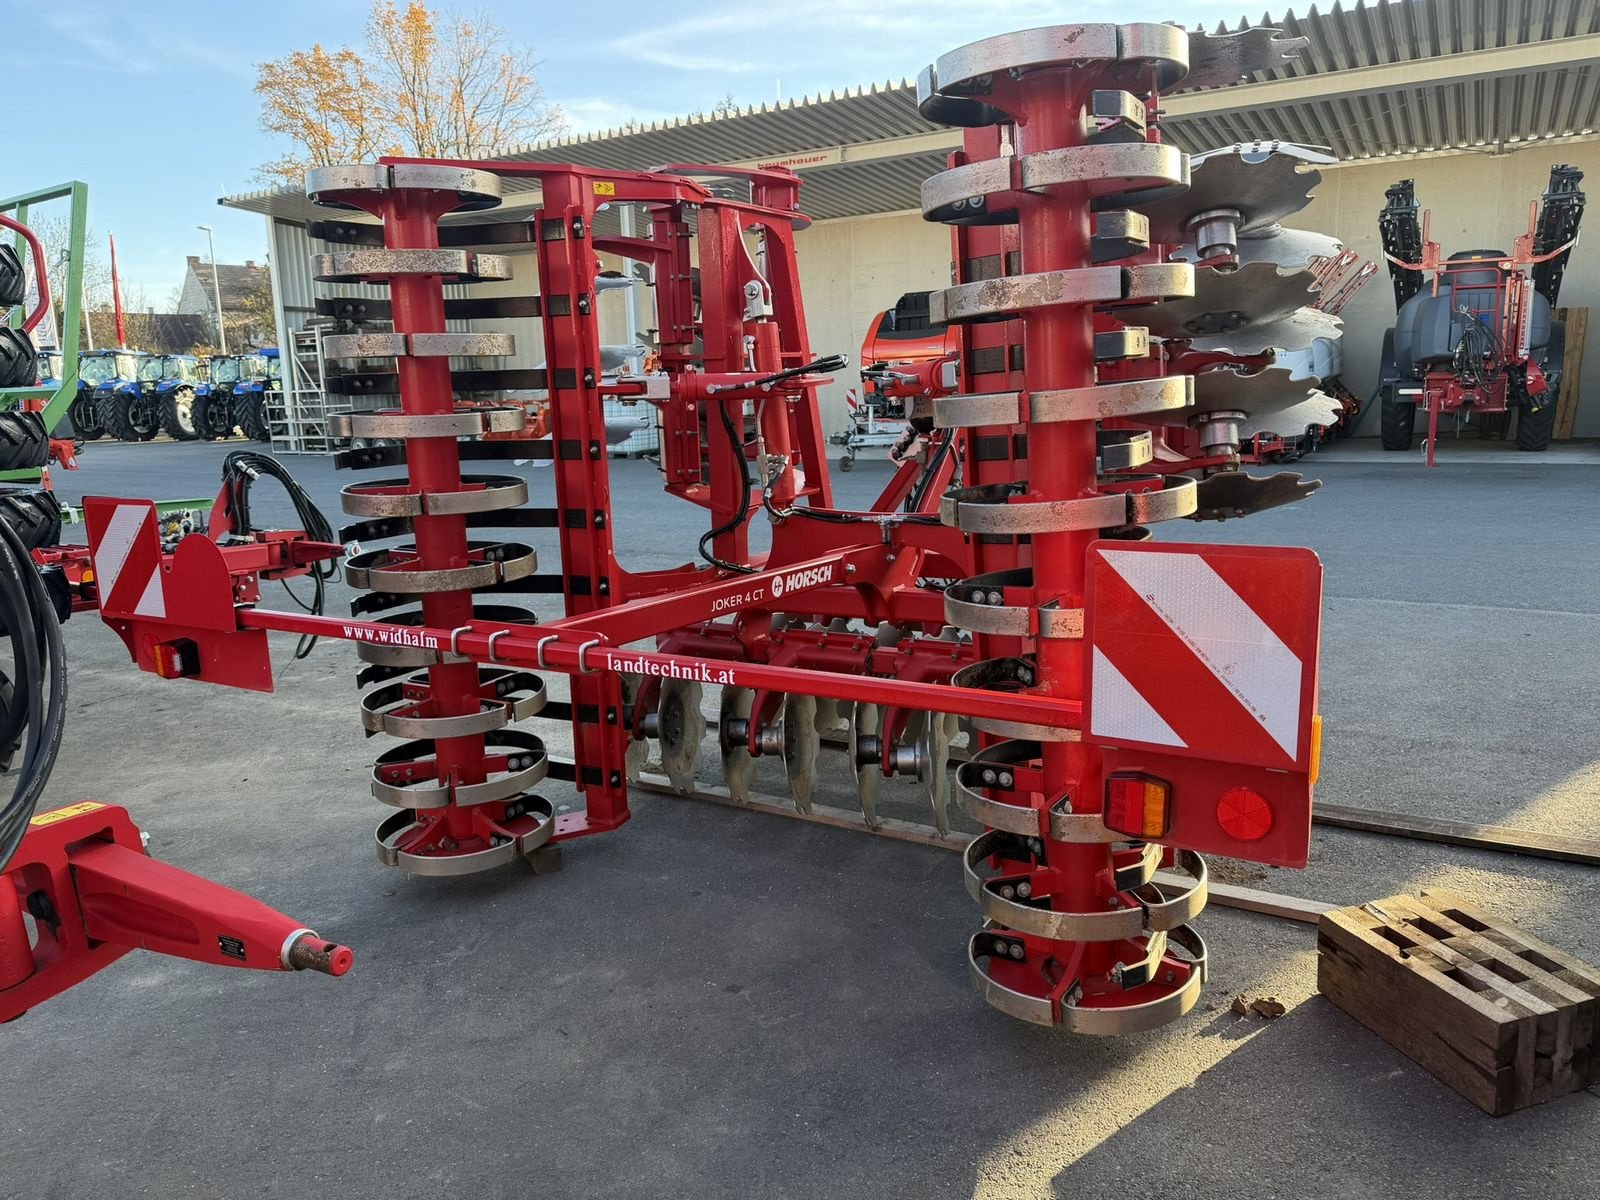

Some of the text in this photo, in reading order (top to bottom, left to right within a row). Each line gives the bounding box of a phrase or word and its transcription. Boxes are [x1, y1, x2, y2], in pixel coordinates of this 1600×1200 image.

[710, 564, 833, 612] JOKER 4 CT HORSCH
[343, 625, 736, 685] www.widhalm landtechnik.at
